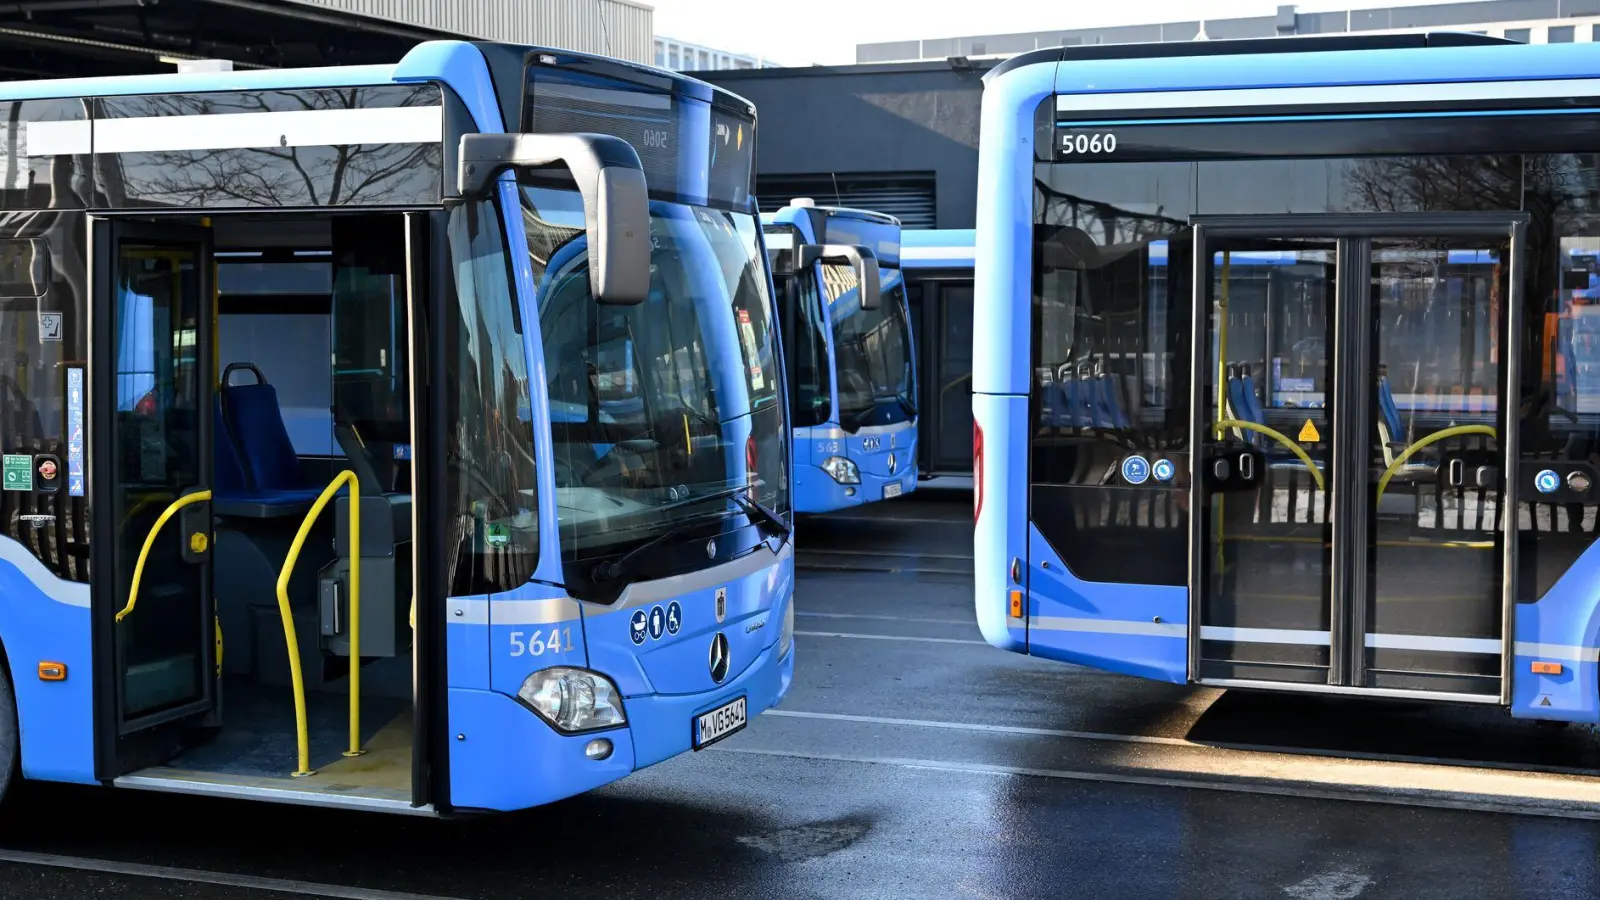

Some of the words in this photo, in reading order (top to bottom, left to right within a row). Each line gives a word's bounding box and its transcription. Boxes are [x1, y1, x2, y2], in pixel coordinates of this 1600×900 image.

[1062, 133, 1117, 154] 5060
[510, 627, 574, 657] 5641
[700, 718, 707, 741] M
